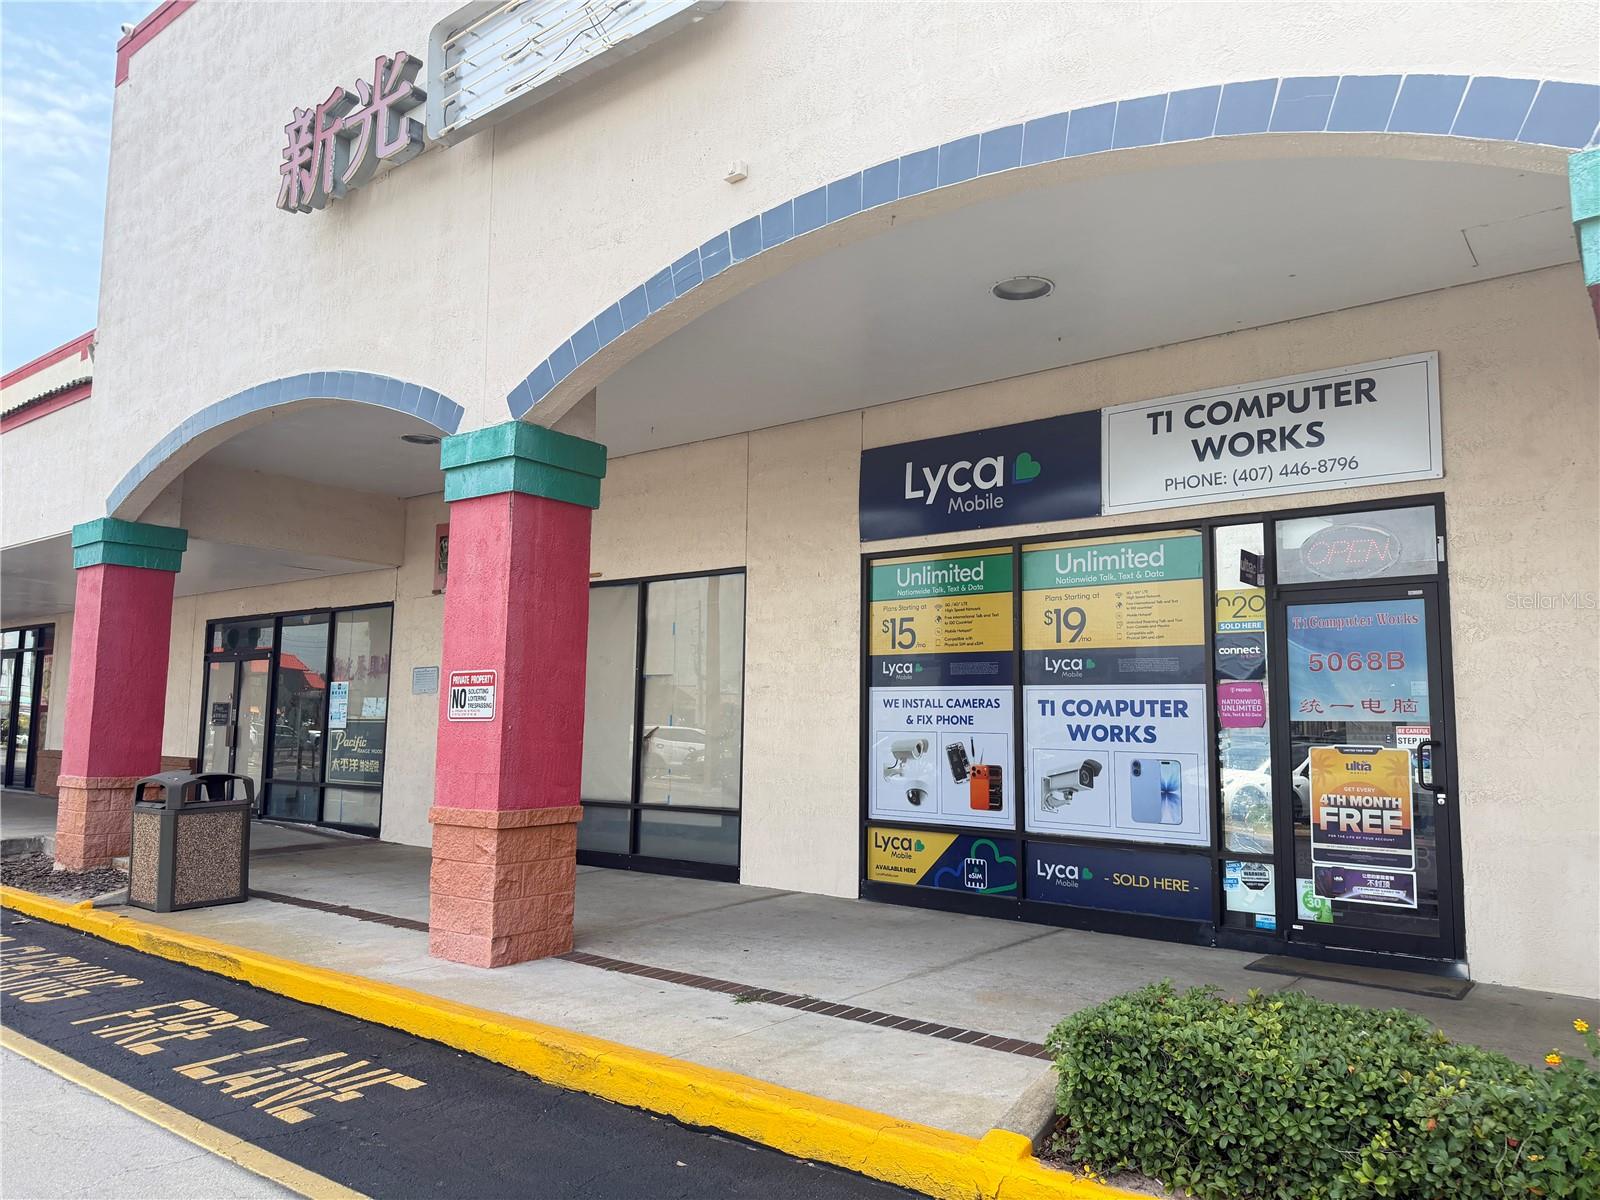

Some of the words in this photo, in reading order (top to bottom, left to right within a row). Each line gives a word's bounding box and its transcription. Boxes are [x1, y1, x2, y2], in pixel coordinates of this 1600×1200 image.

[276, 50, 424, 212] 新光
[1184, 377, 1378, 429] COMPUTER
[1191, 421, 1326, 462] WORKS
[905, 455, 1005, 505] Lyca
[1164, 471, 1228, 492] PHONE:
[1232, 464, 1274, 487] (407)
[1279, 455, 1359, 479] 446-8796
[947, 493, 1004, 514] Mobile
[1055, 544, 1165, 575] Unlimited
[1306, 538, 1394, 566] OPEN
[896, 560, 984, 587] Unlimited
[1055, 575, 1098, 585] Nationwide
[1118, 572, 1134, 580] Text
[1145, 570, 1165, 578] Data
[897, 588, 931, 597] Nationwide
[1044, 594, 1062, 602] Plans
[1064, 593, 1091, 602] Starting
[898, 604, 920, 612] Starting
[1219, 622, 1241, 630] SOLD
[1242, 621, 1262, 629] HERE
[1376, 611, 1420, 626] Works
[1218, 645, 1261, 655] connect
[882, 661, 913, 676] Lyca
[1044, 656, 1083, 674] Lyca
[1308, 650, 1406, 672] 5068B
[1061, 671, 1083, 679] Mobile
[451, 688, 467, 709] NO
[883, 698, 899, 709] WE
[901, 698, 944, 709] INSTALL
[945, 698, 1001, 710] CAMERAS
[1298, 698, 1420, 714] 统一电脑
[1061, 699, 1189, 719] COMPUTER
[905, 715, 914, 726] &
[916, 714, 934, 726] FIX
[936, 714, 974, 726] PHONE
[331, 729, 367, 752] Pacific
[1067, 723, 1158, 744] WORKS
[1397, 737, 1418, 745] STEP
[1345, 760, 1372, 772] ultra
[1319, 793, 1346, 806] 4TH
[1349, 795, 1403, 808] MONTH
[1319, 807, 1404, 836] FREE
[874, 831, 912, 852] Lyca
[890, 851, 912, 860] Mobile
[875, 864, 902, 873] AVAILABLE
[968, 872, 983, 880] eSIM
[1037, 859, 1079, 882] Lyca
[1055, 878, 1079, 888] Mobile
[1112, 873, 1150, 889] SOLD
[1153, 876, 1190, 893] HERE
[71, 999, 270, 1056] FIRE
[172, 1037, 428, 1125] LANE
